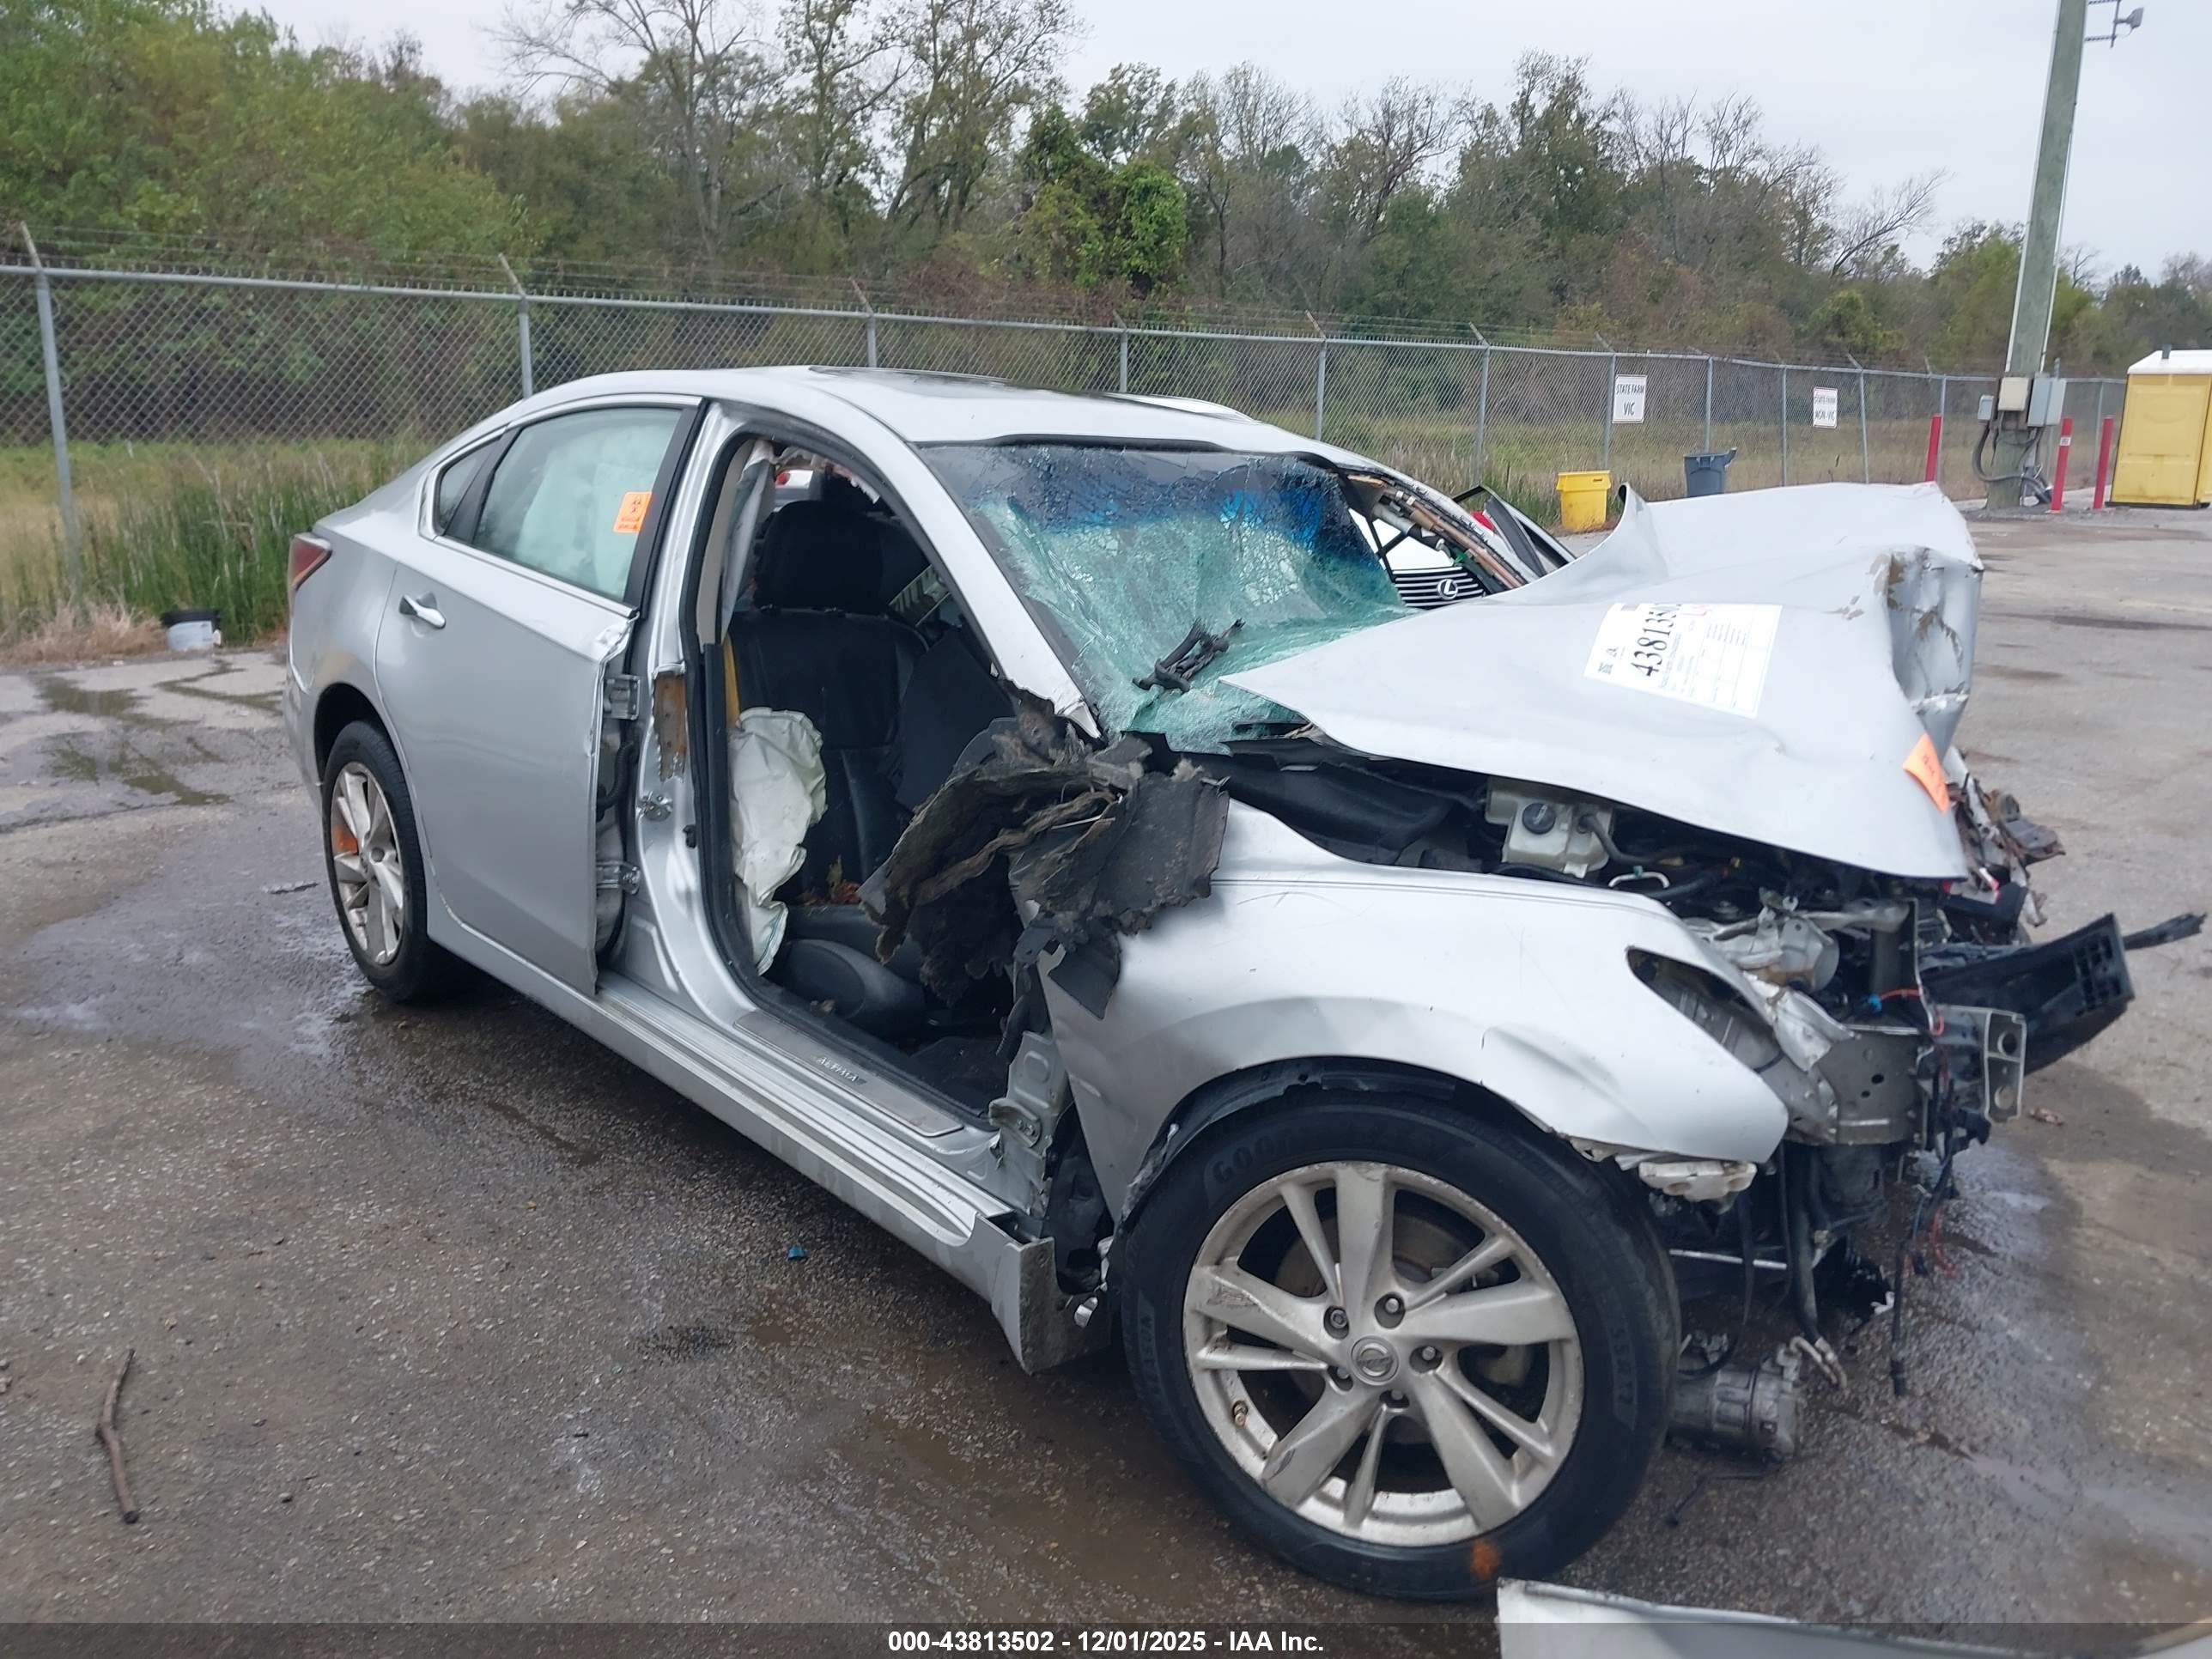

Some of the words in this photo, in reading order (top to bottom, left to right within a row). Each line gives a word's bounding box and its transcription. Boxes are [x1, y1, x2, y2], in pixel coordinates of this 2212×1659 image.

[1616, 384, 1632, 395] STATE
[1632, 384, 1644, 394] FARM
[1623, 403, 1635, 416] VIC
